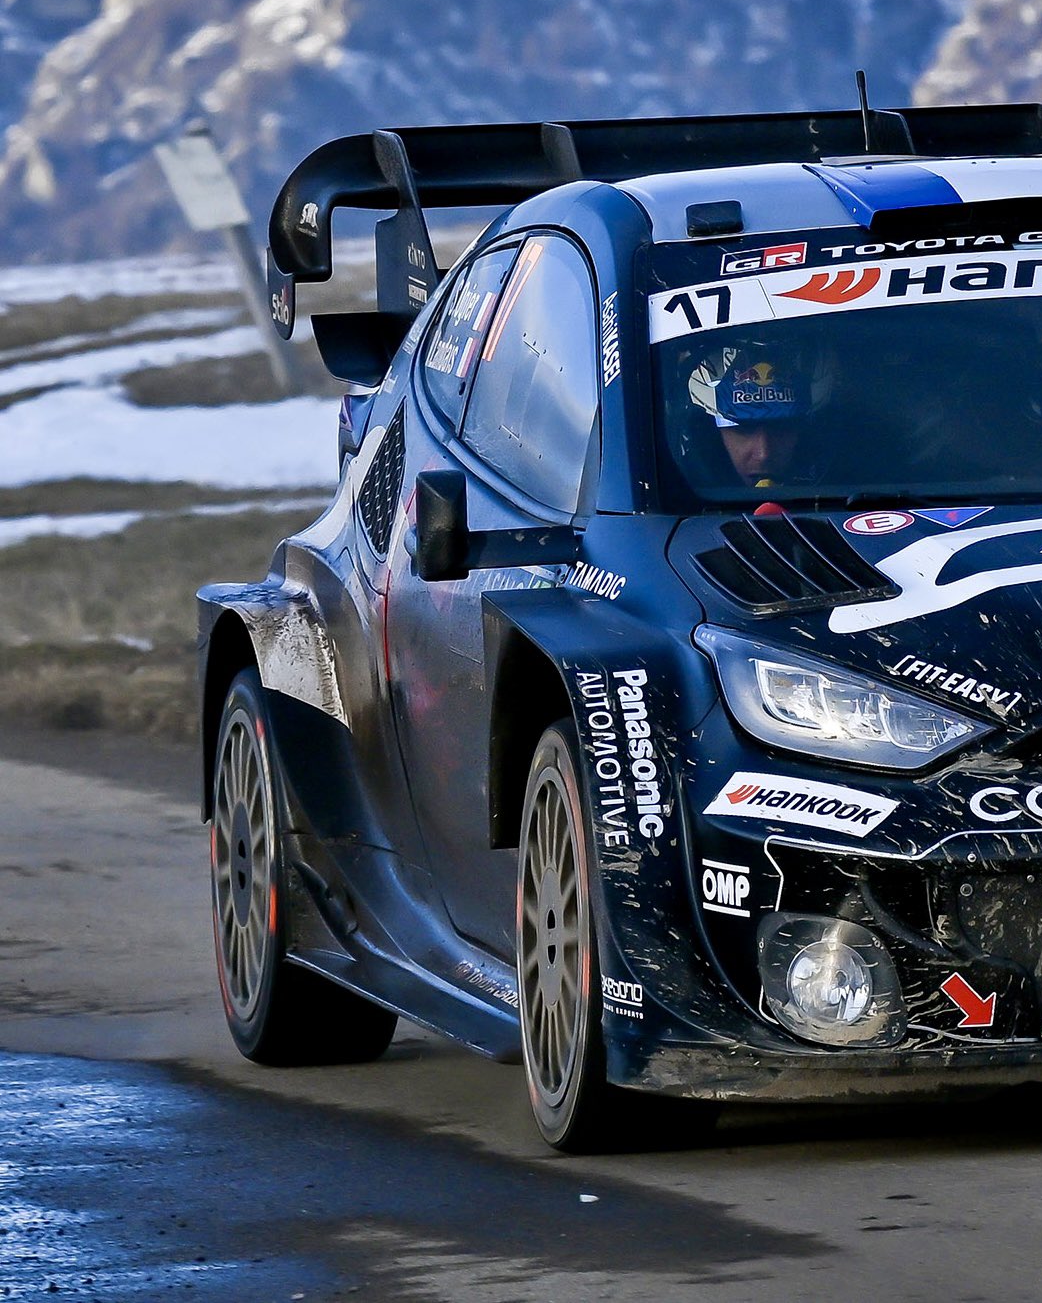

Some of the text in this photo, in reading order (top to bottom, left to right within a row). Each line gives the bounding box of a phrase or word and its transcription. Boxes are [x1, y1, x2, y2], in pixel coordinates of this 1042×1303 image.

[723, 248, 805, 274] GR
[820, 235, 1004, 258] TOYOTA
[664, 285, 731, 330] 17
[732, 386, 795, 405] Red Bull
[864, 515, 894, 530] E
[568, 560, 628, 601] TAMADIC
[576, 672, 631, 848] AUTOMOTIVE
[612, 668, 664, 839] Panasonic
[702, 868, 751, 907] OMP
